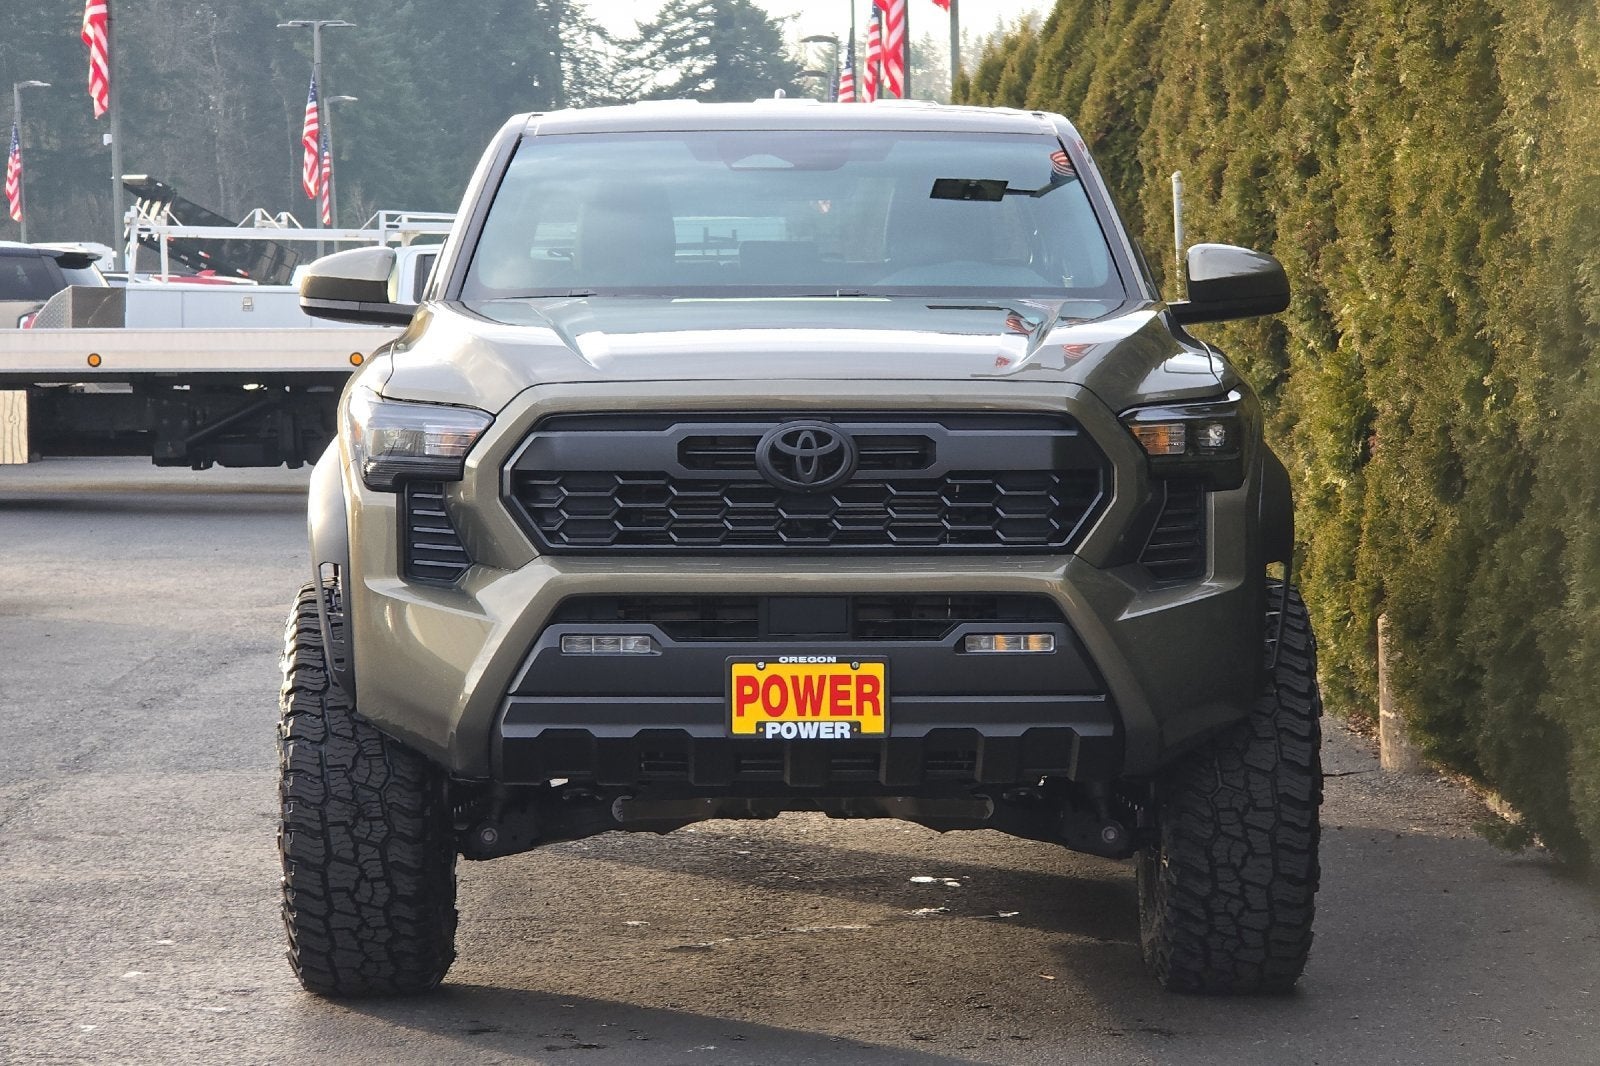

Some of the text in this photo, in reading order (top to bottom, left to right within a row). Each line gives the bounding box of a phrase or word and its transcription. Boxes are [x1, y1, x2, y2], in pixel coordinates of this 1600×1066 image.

[778, 656, 837, 664] OREGON
[736, 674, 881, 718] POWER
[765, 721, 851, 739] POWER
